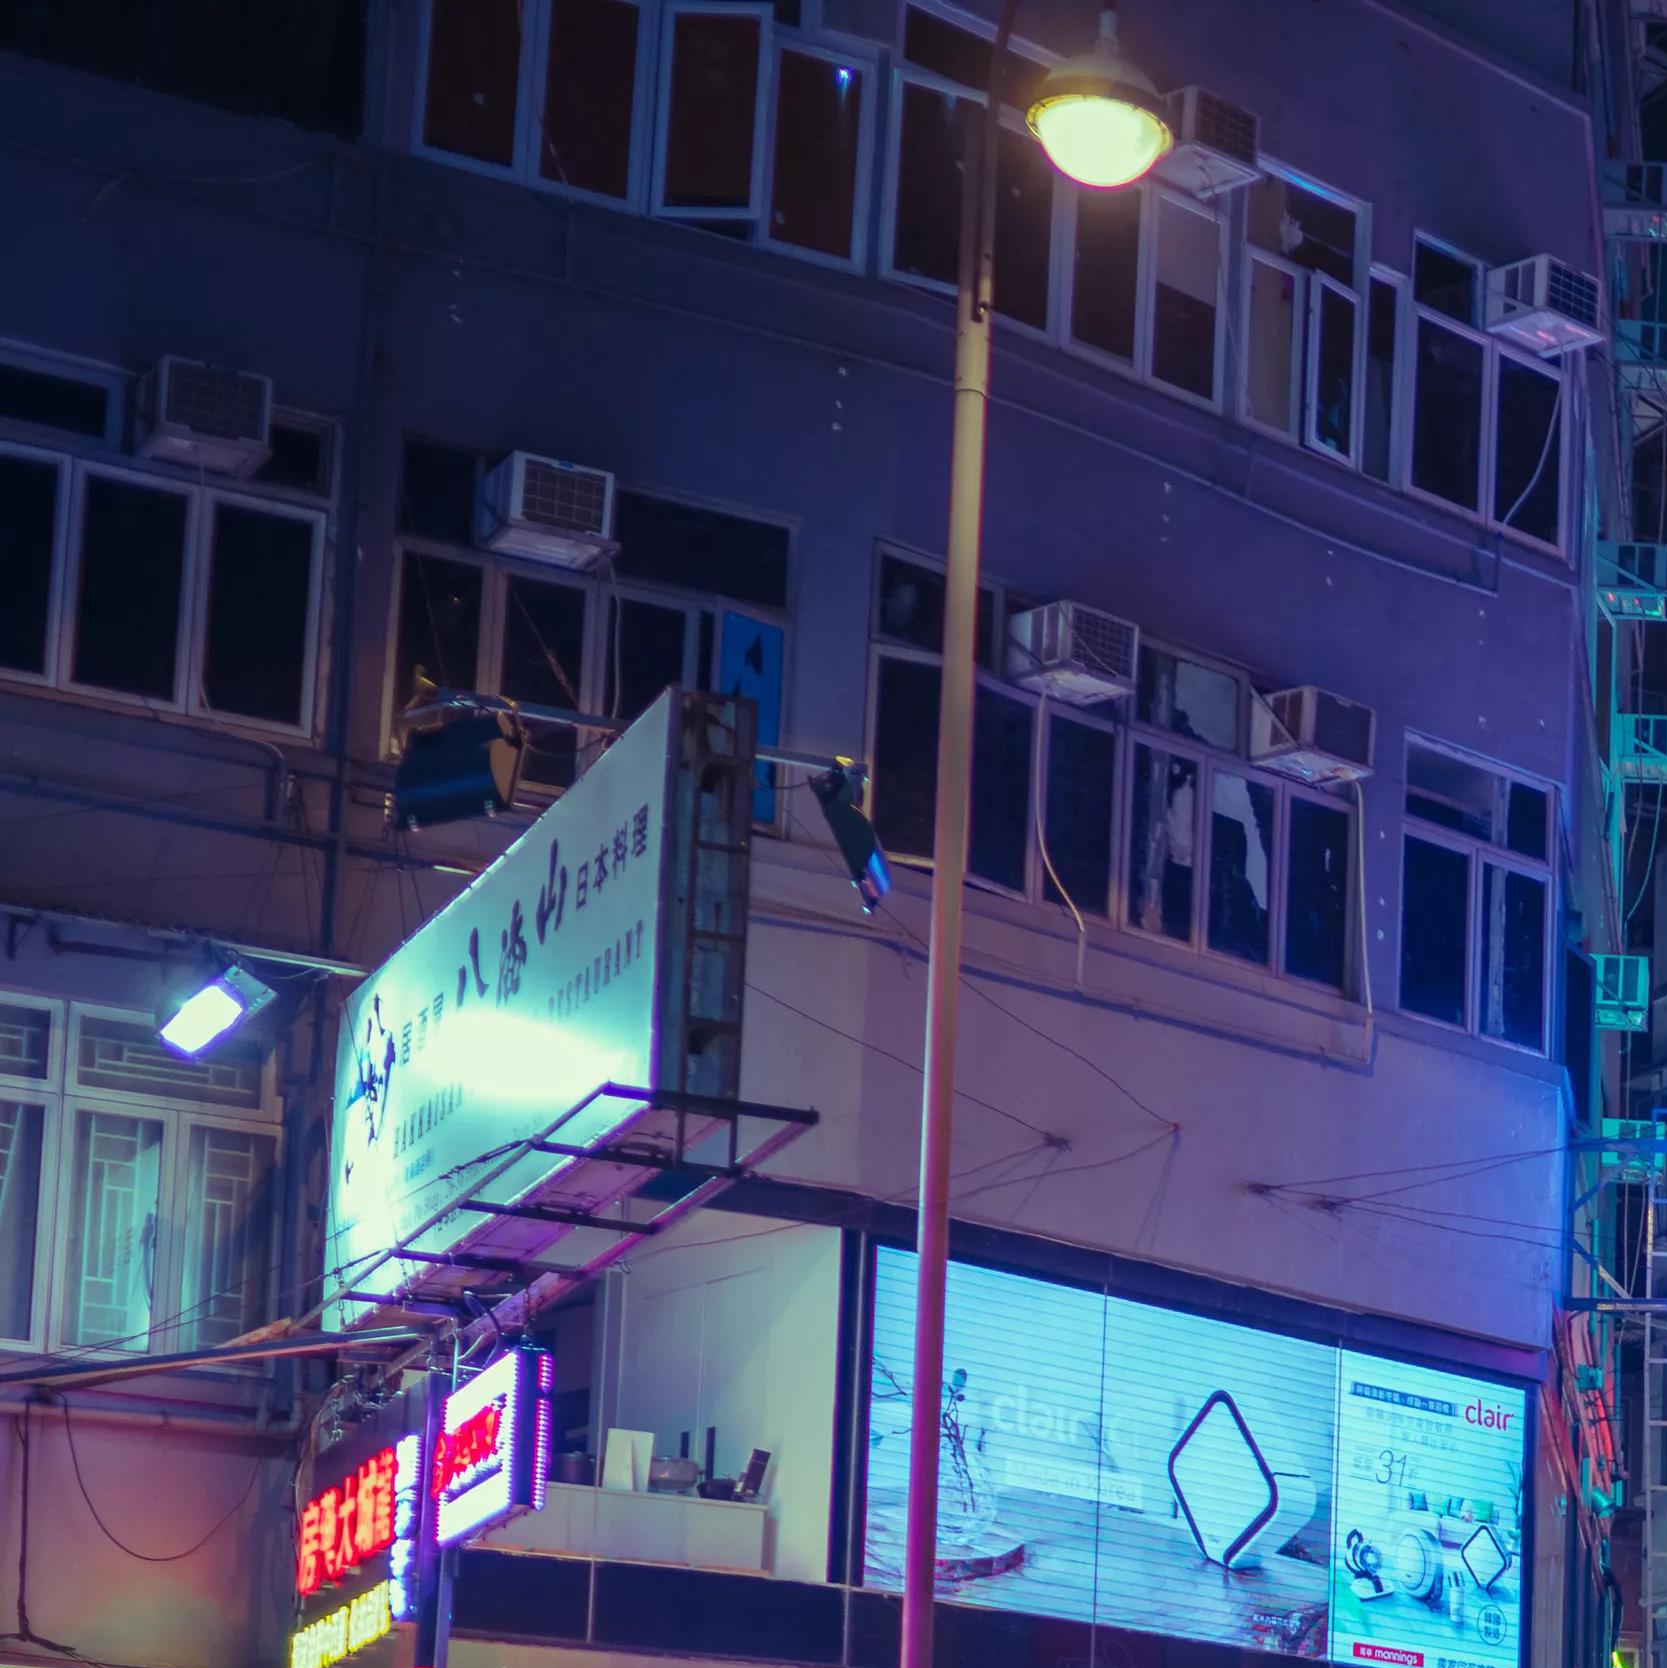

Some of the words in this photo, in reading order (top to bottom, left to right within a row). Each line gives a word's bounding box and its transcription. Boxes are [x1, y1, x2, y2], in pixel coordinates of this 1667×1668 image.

[573, 803, 650, 912] 日本料理
[456, 838, 568, 1006] 八海山
[548, 918, 646, 1018] RESTAURANT
[1465, 1399, 1514, 1432] clair
[1374, 1648, 1418, 1666] mannings
